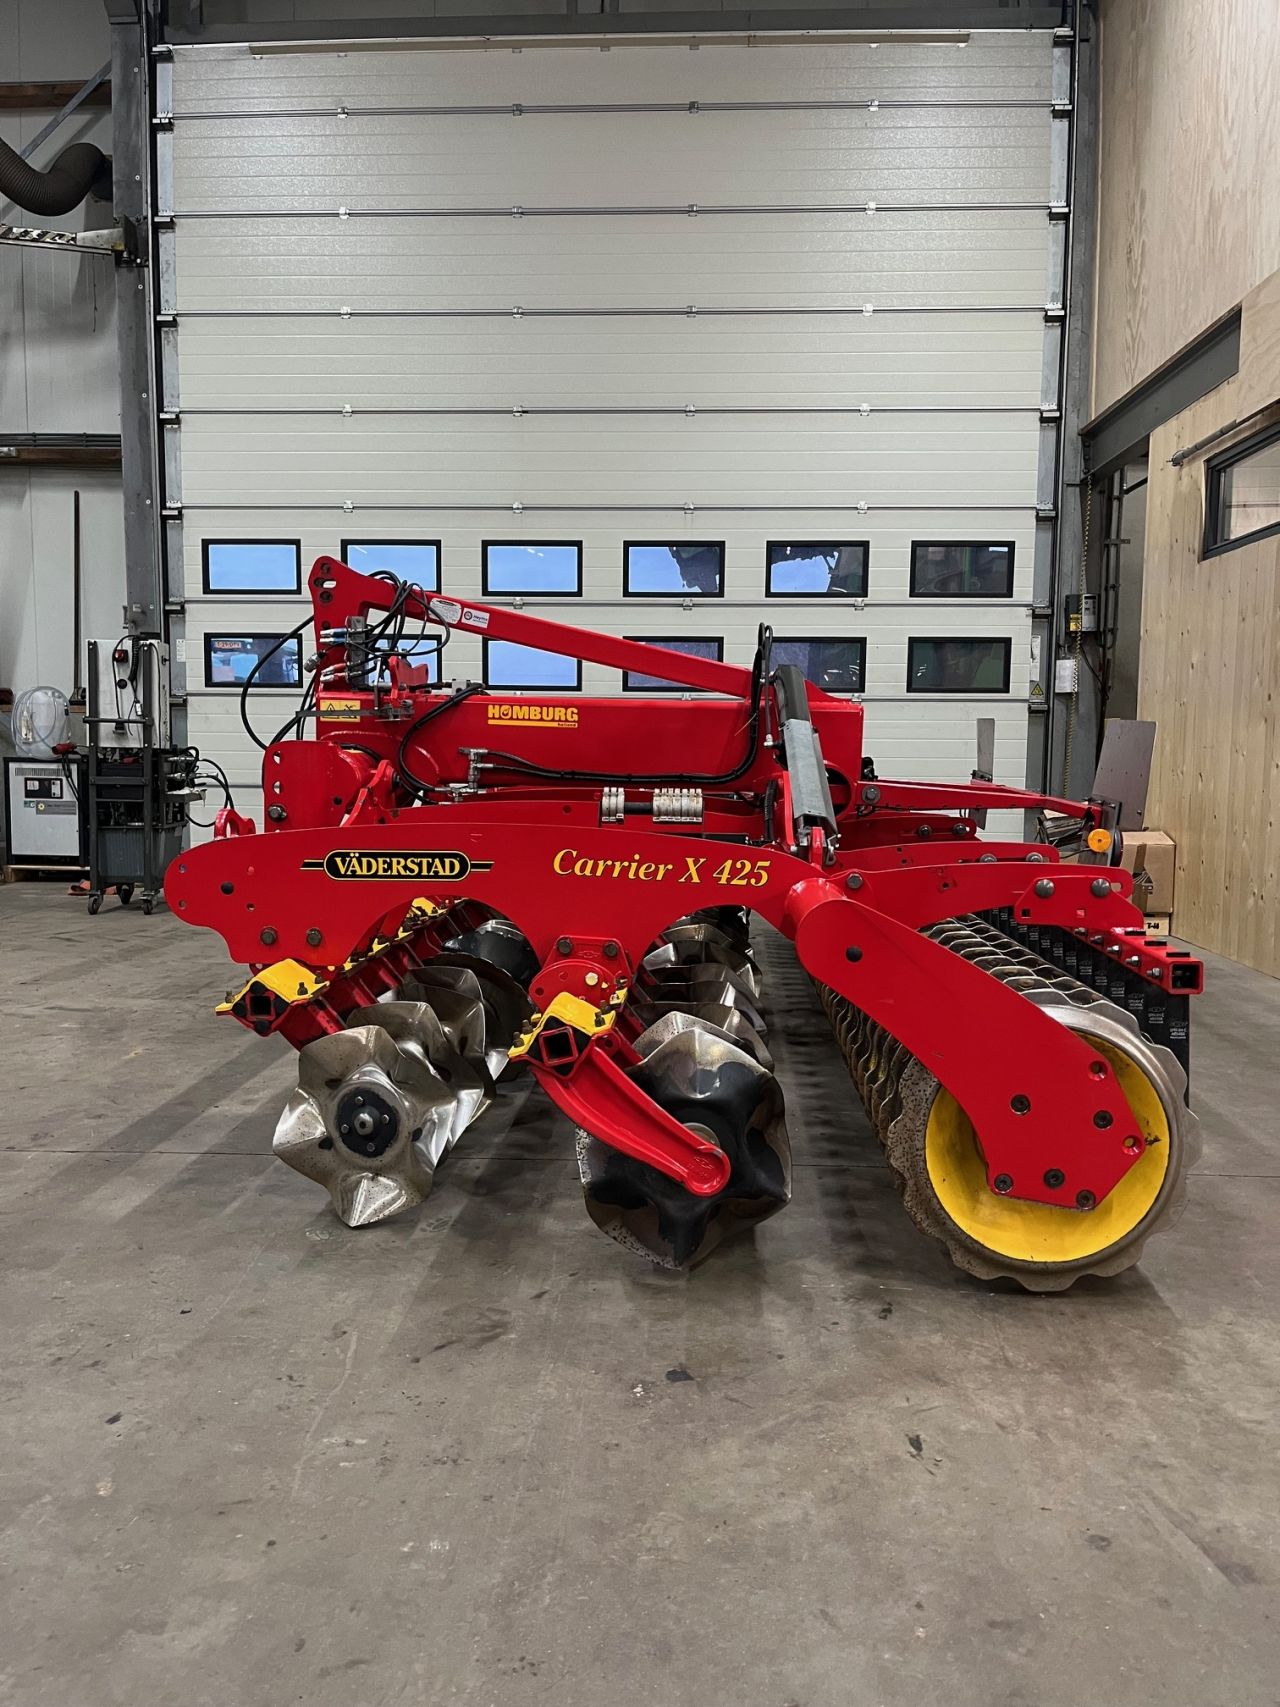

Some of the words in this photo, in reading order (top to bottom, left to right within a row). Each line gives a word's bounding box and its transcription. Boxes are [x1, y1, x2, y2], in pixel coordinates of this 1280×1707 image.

[487, 704, 579, 722] HOMBURG
[334, 852, 460, 876] VÄDERSTAD
[552, 848, 673, 882] Carrier
[678, 857, 707, 883] X
[712, 858, 771, 887] 425
